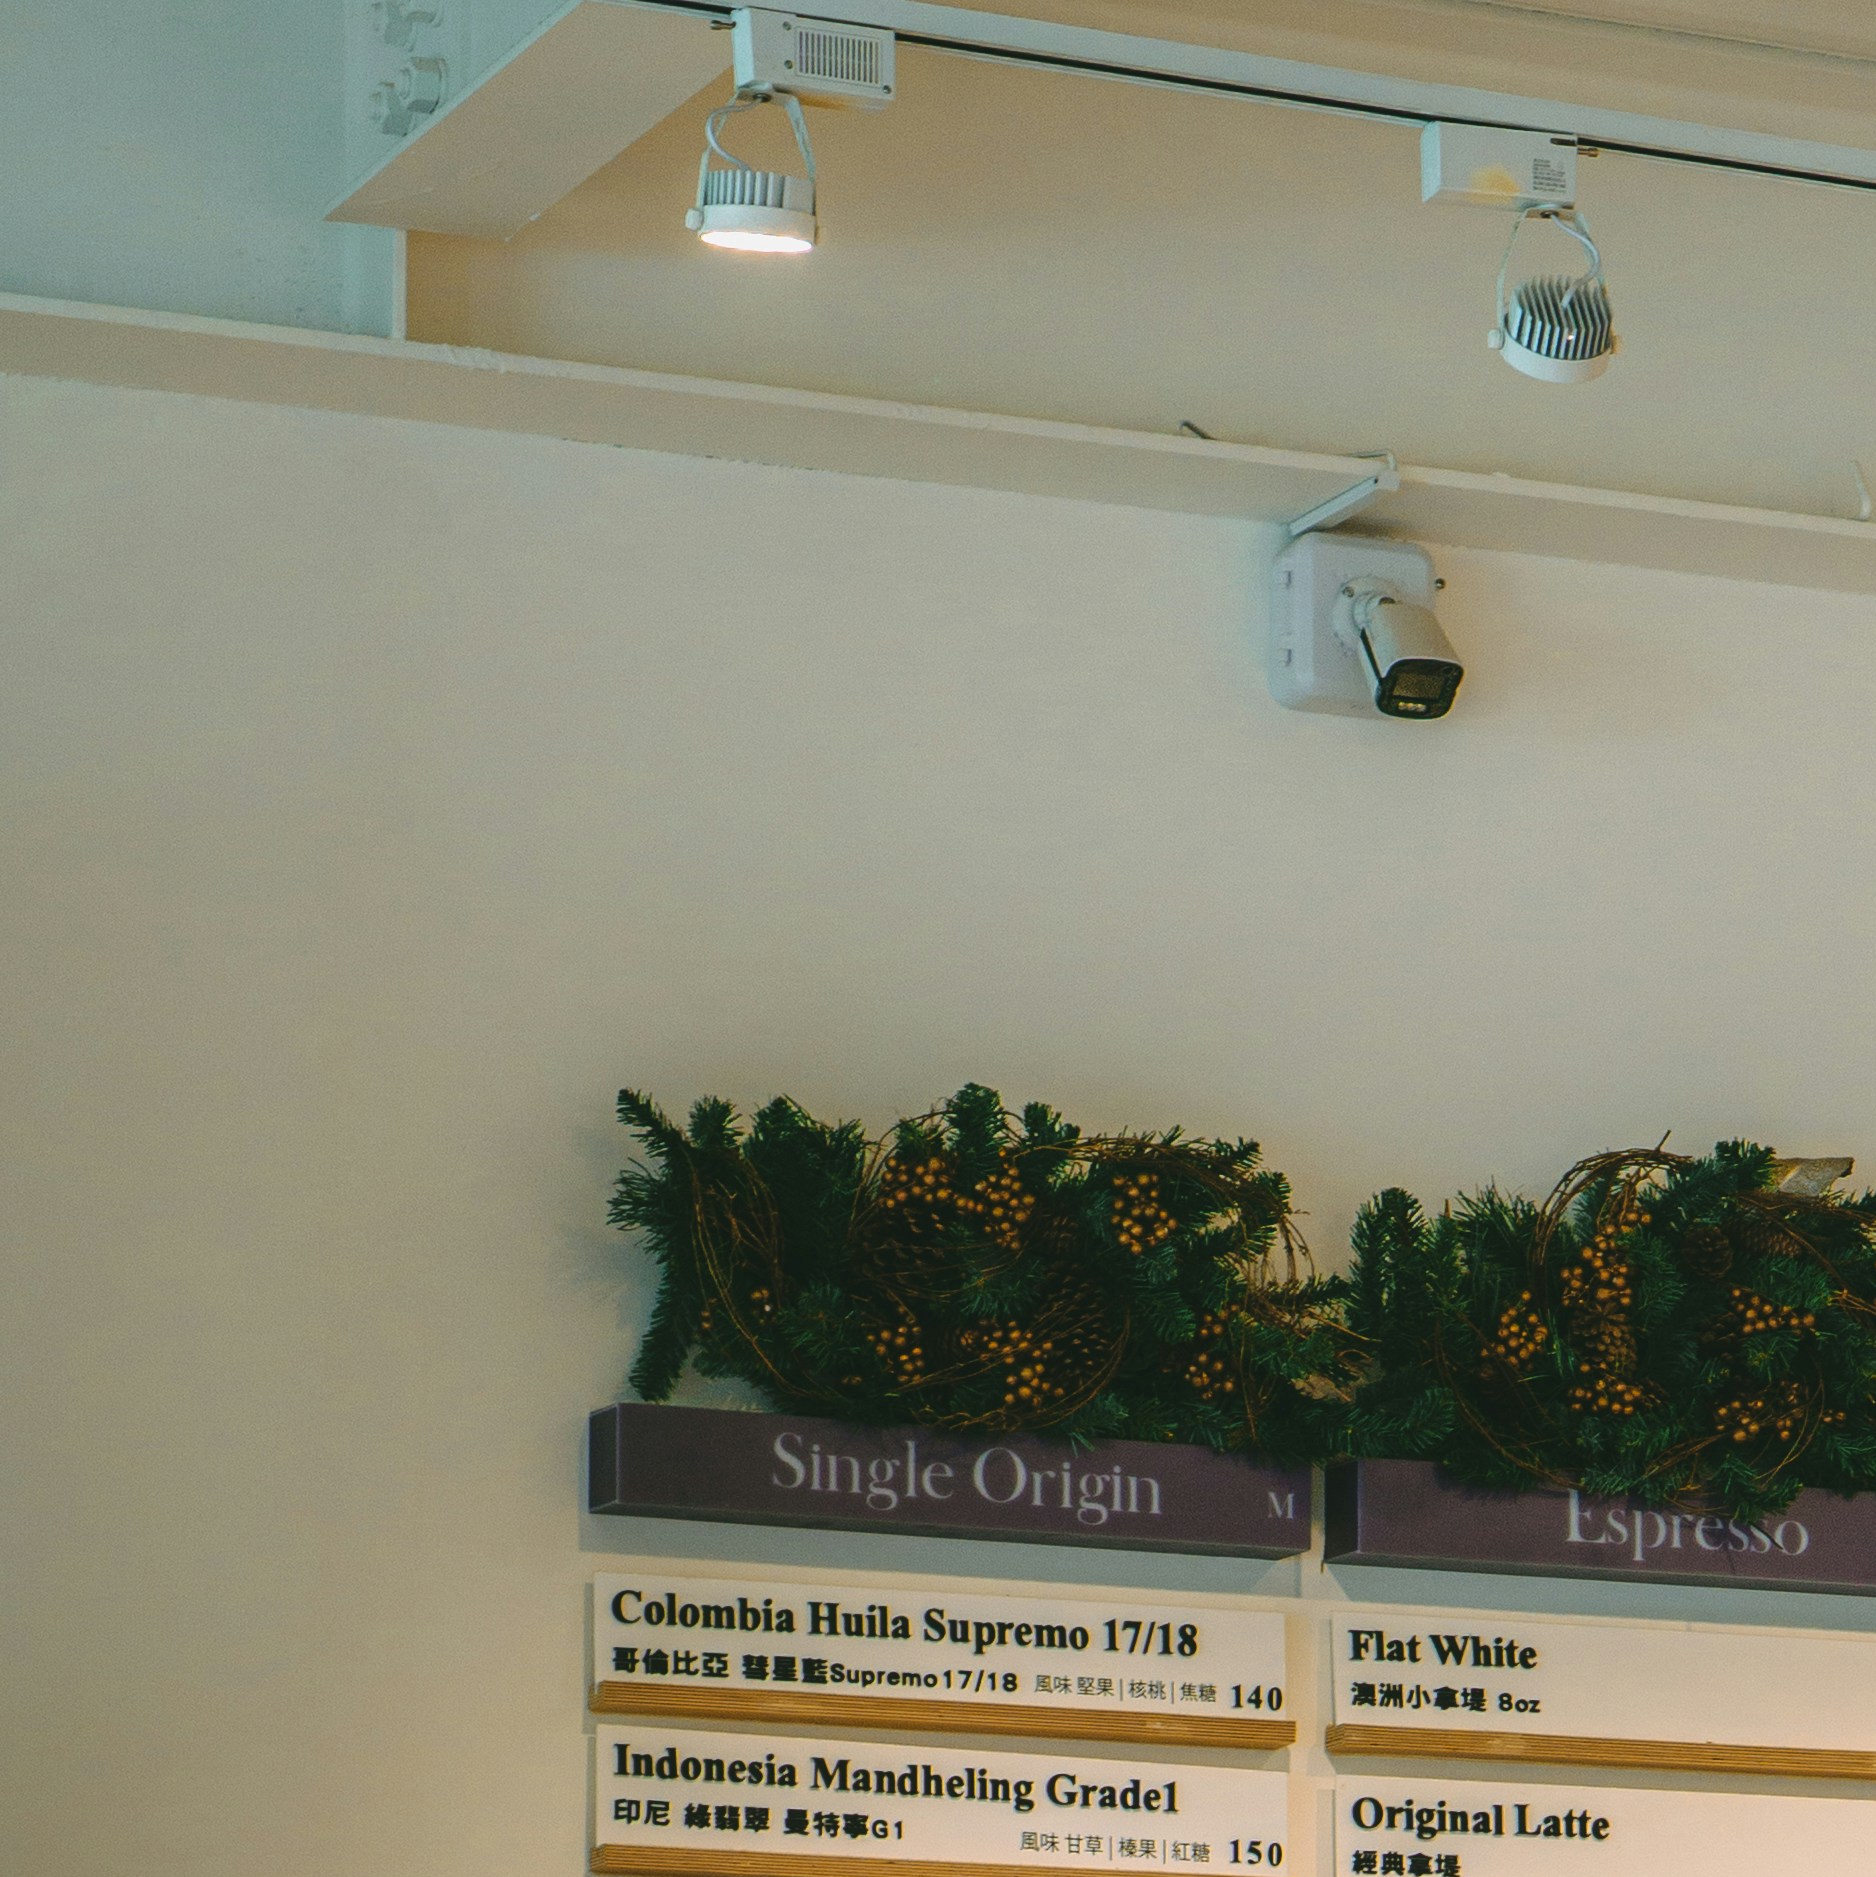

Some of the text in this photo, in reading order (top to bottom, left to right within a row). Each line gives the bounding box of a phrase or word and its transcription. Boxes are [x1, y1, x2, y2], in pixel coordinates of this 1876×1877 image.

[773, 1435, 1161, 1525] Single Origin
[1566, 1490, 1810, 1563] Espresso
[611, 1589, 1198, 1657] Colombia Huila Supremo 17/18
[612, 1646, 729, 1678] 哥倫比亞
[1348, 1629, 1537, 1670] Flat White
[1232, 1684, 1283, 1711] 140
[614, 1743, 1178, 1813] Indonesia Mandheling Grade1
[1351, 1797, 1610, 1841] Original Latte
[1230, 1839, 1283, 1867] 150
